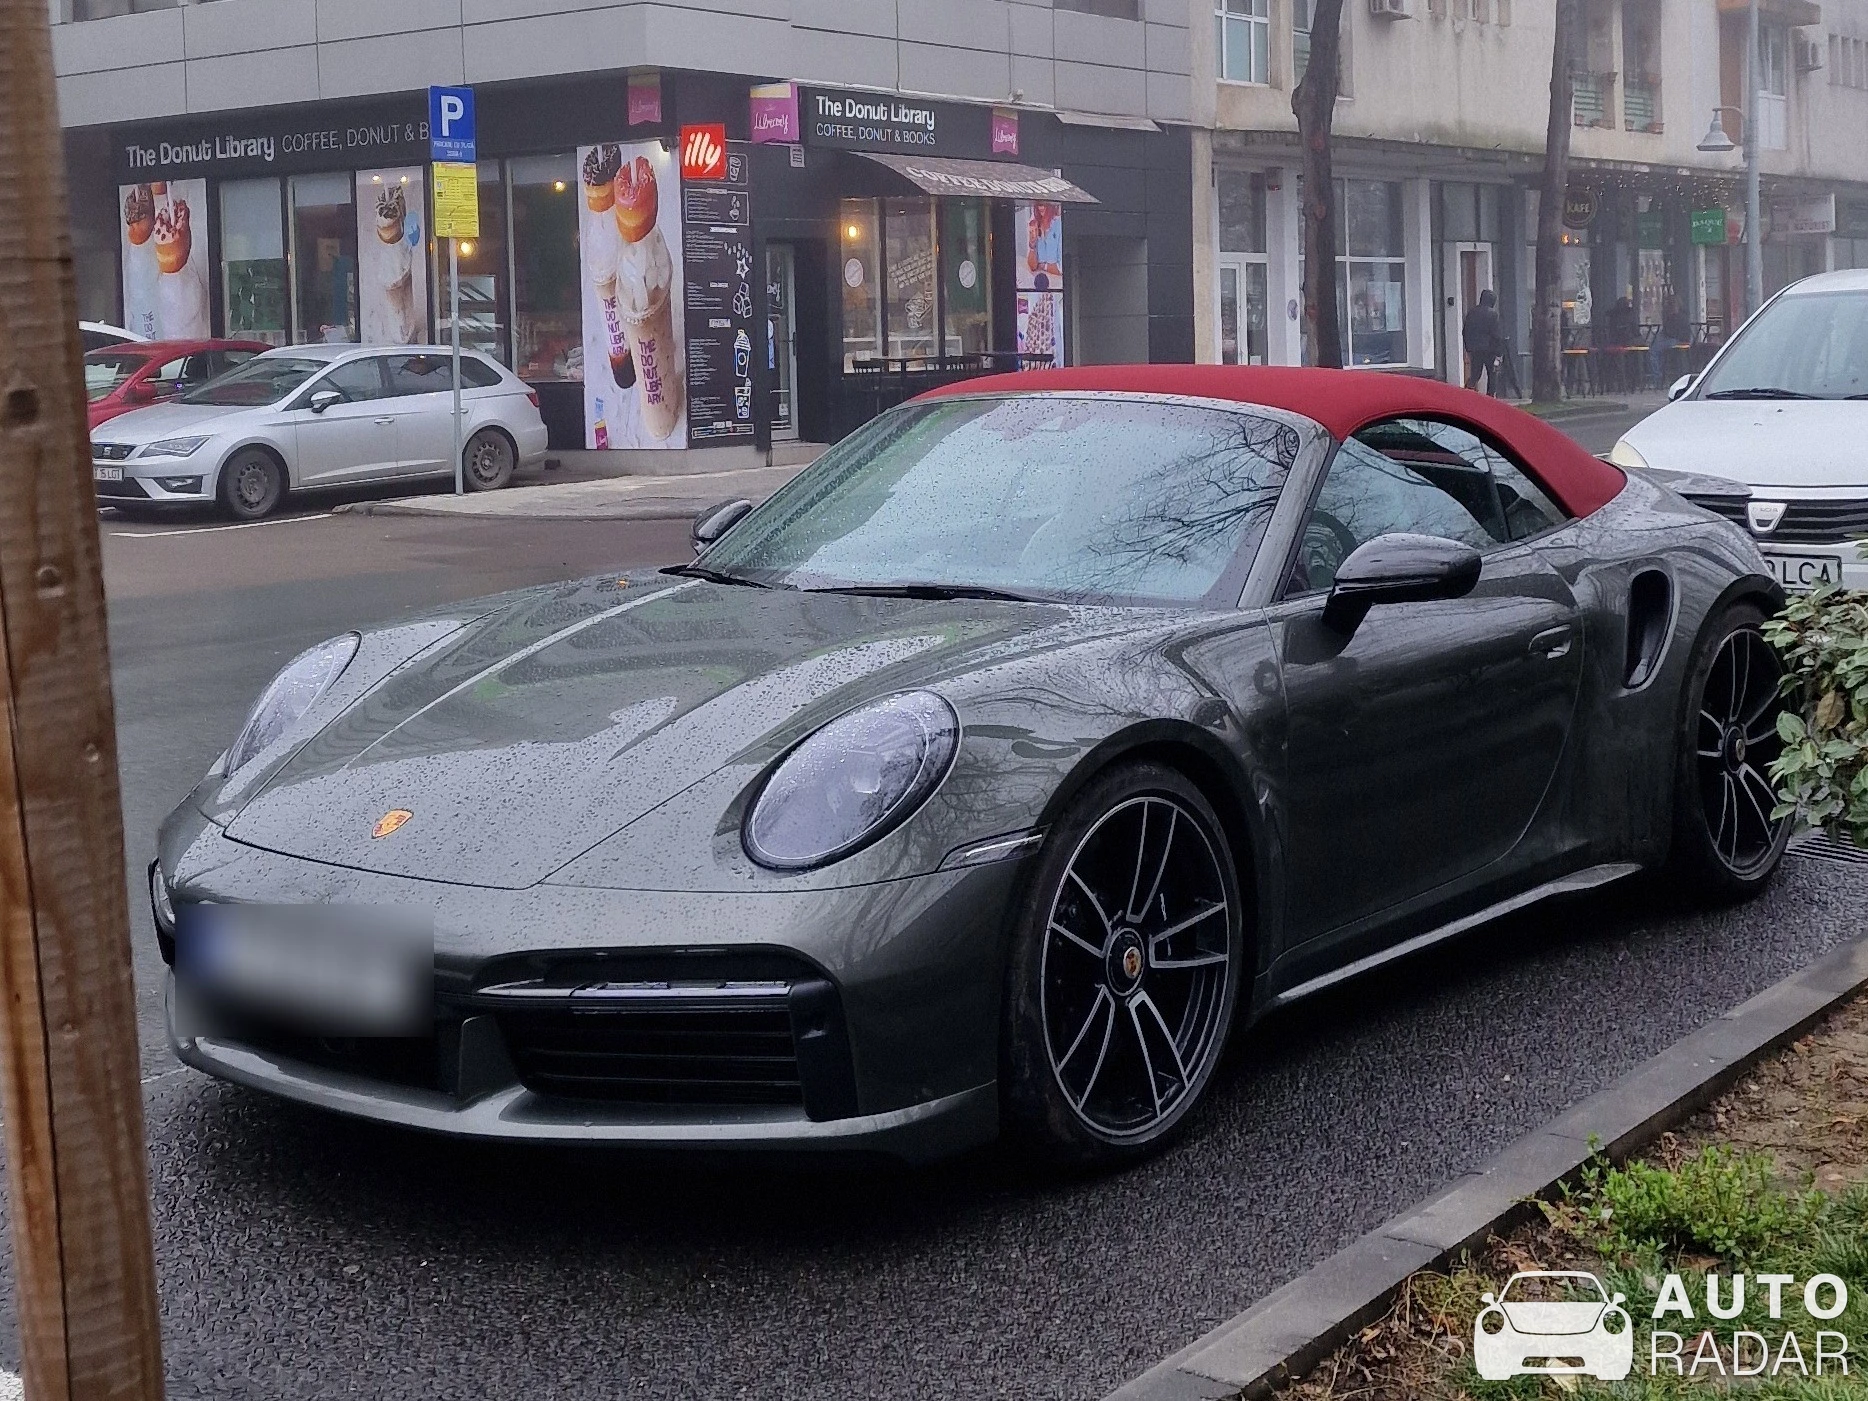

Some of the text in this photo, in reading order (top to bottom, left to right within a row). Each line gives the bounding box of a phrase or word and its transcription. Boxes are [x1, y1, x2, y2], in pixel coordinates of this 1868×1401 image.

[440, 95, 464, 137] P
[816, 95, 935, 131] The Donut Library
[125, 145, 156, 168] The
[160, 139, 212, 165] Donut
[215, 135, 275, 162] Library
[281, 130, 343, 153] COFFEE,
[347, 124, 400, 147] DONUT
[404, 123, 415, 141] &
[684, 131, 722, 174] illy
[816, 122, 936, 145] COFFEE, DONUT & BOOKS
[1782, 560, 1832, 585] LCA
